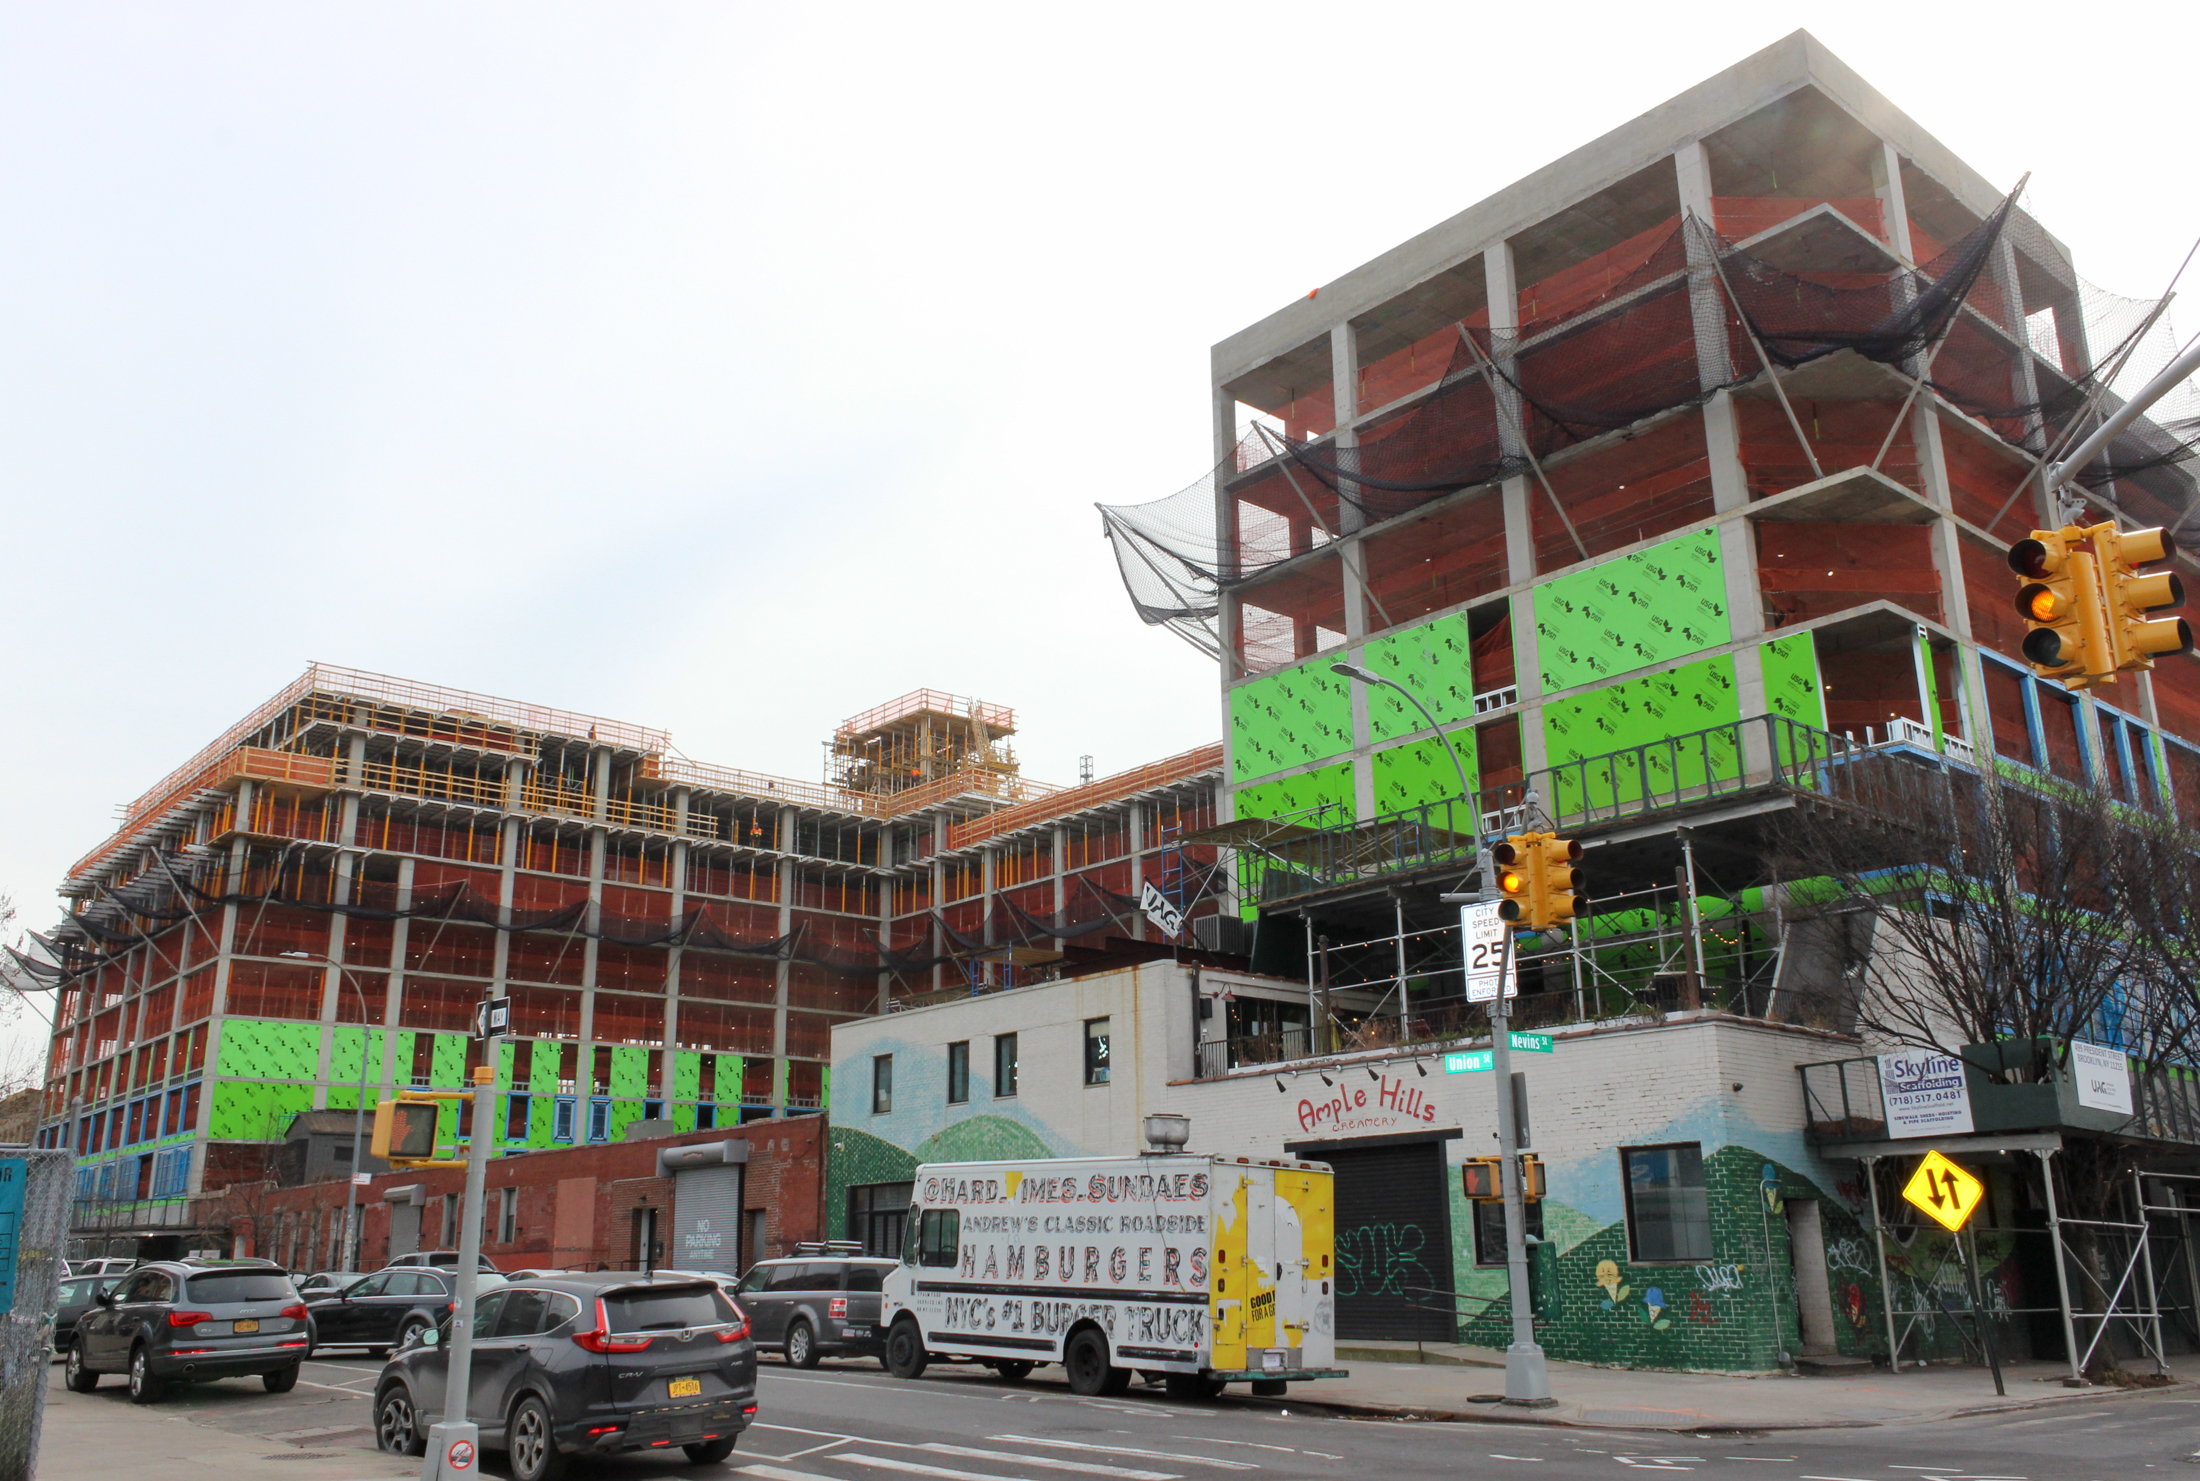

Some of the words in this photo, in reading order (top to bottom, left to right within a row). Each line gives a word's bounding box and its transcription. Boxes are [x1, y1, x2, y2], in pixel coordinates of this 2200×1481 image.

[1476, 906, 1494, 917] CITY
[1472, 918, 1500, 929] SPEED
[1476, 929, 1498, 940] LIMIT
[1472, 941, 1504, 969] 25
[1472, 984, 1512, 996] ENFORD
[1479, 978, 1499, 988] PHOT
[1511, 1034, 1540, 1050] Nevins
[1542, 1036, 1548, 1046] St
[2084, 1045, 2107, 1058] PRESIDENT
[2108, 1050, 2123, 1060] STREET
[1449, 1054, 1480, 1071] Union
[1483, 1054, 1490, 1063] St
[1894, 1056, 1959, 1080] Skyline
[2103, 1060, 2109, 1068] NY
[1900, 1078, 1959, 1091] Scaffolding
[1298, 1083, 1367, 1132] Ample
[1380, 1074, 1436, 1122] Hills
[1889, 1096, 1913, 1106] (718)
[1915, 1090, 1961, 1103] 517.0481
[697, 1220, 710, 1232] NO
[962, 1216, 1039, 1233] ANDREW'S
[1044, 1215, 1114, 1234] CLASSIC
[1119, 1214, 1208, 1234] ROADSIDE
[686, 1233, 721, 1247] PARKING
[689, 1249, 714, 1259] ANYTIME
[960, 1244, 1208, 1288] HAMBURGERS
[1250, 1292, 1272, 1309] GOOD
[1251, 1307, 1263, 1322] FOR
[1002, 1300, 1025, 1332] #1
[1124, 1306, 1205, 1345] TRUCK
